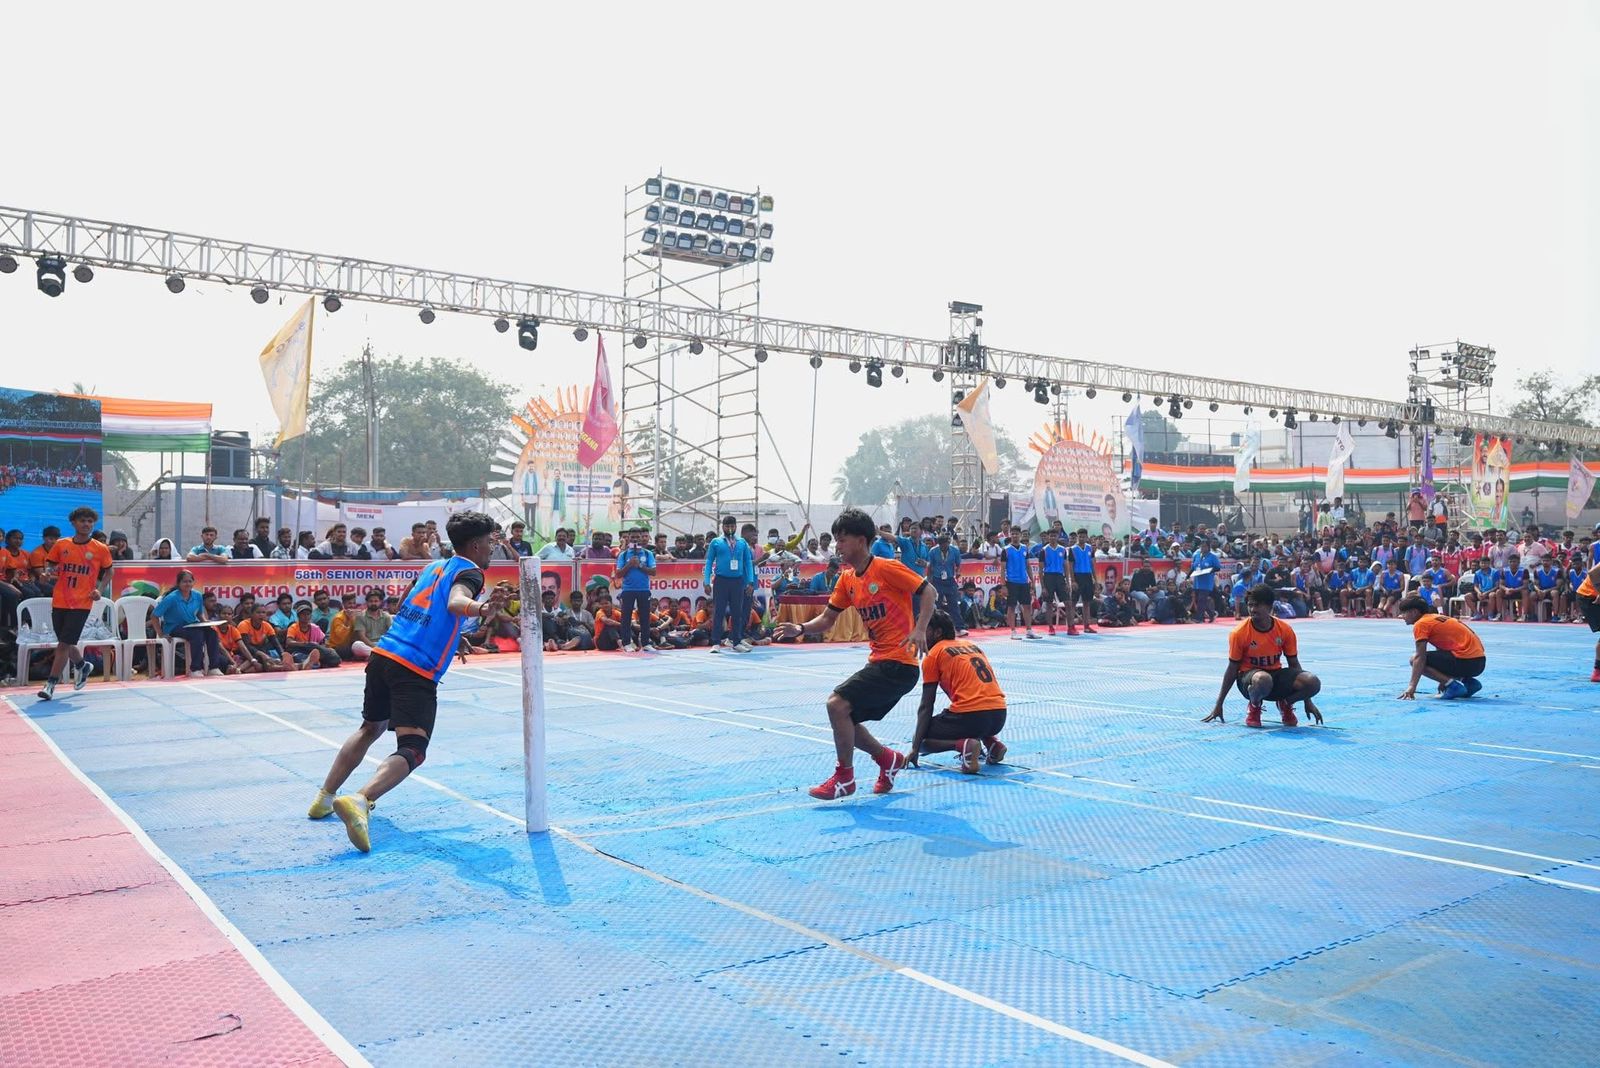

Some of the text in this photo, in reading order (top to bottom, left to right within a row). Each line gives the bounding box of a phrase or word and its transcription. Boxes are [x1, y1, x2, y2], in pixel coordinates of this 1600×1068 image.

[295, 570, 322, 579] 58th
[327, 570, 373, 579] SENIOR
[67, 576, 78, 588] 11
[969, 656, 993, 683] 8
